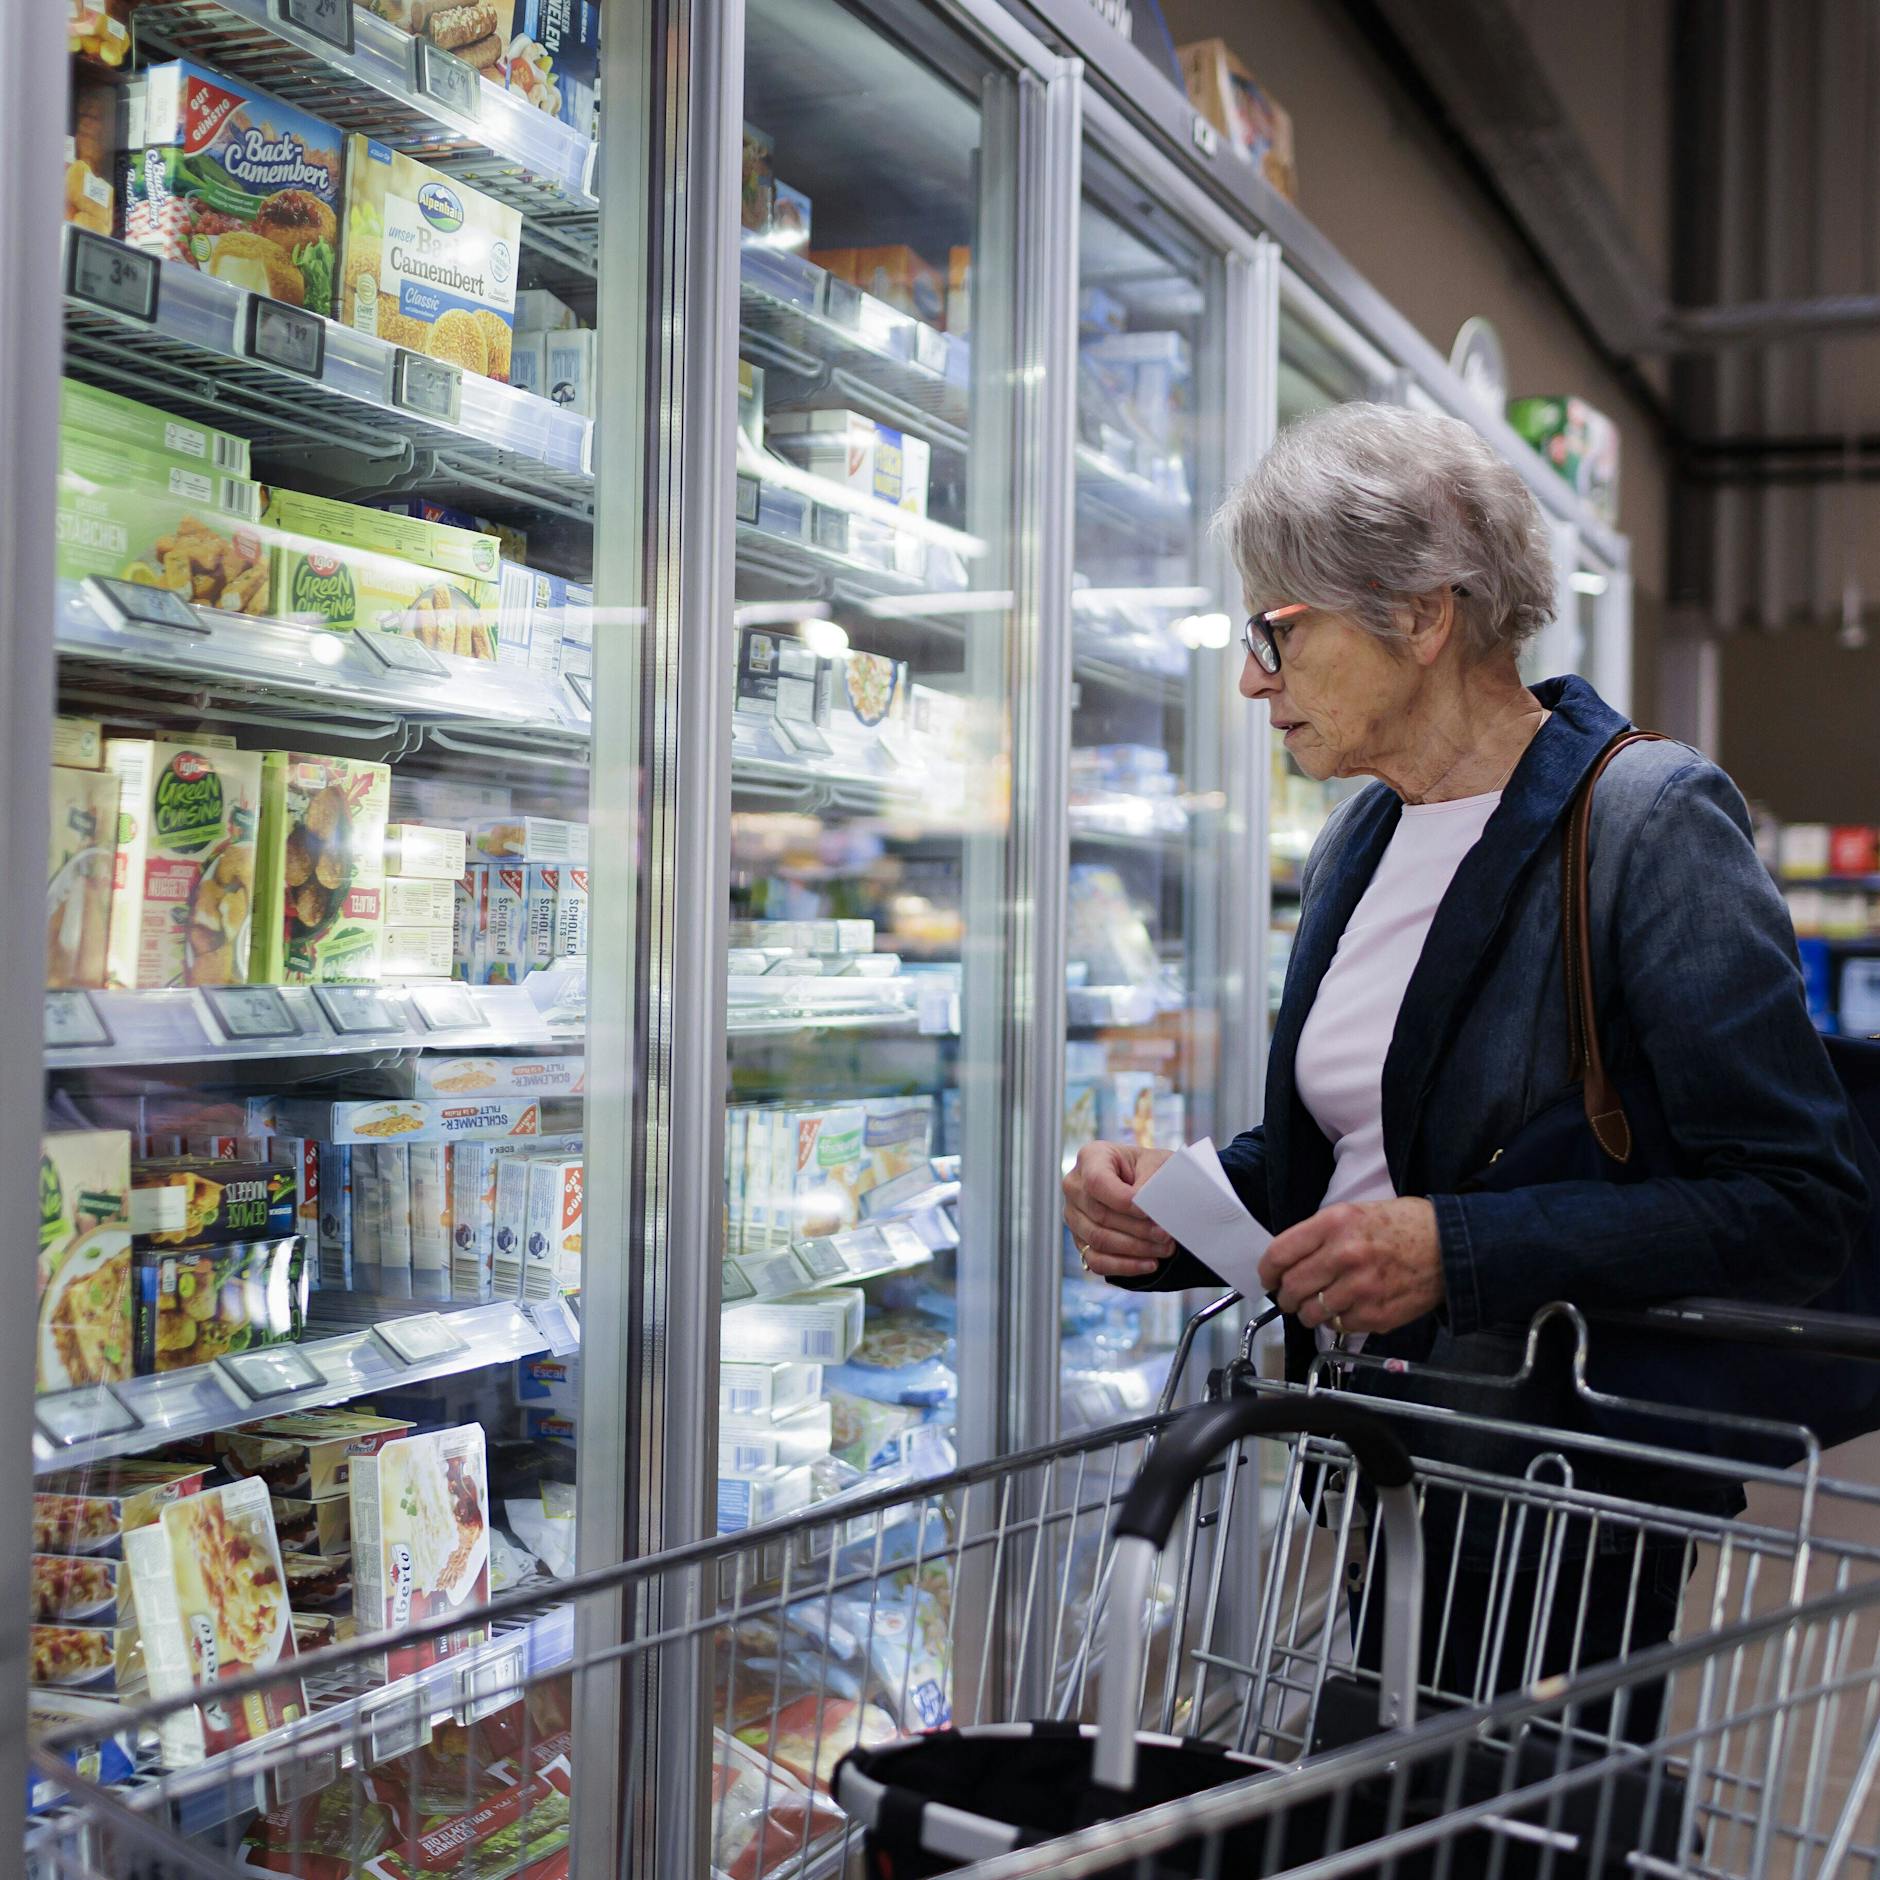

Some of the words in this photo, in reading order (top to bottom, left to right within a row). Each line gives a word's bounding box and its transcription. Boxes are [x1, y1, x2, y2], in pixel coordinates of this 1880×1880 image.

[190, 87, 210, 111] GUT
[201, 104, 212, 117] &
[245, 129, 303, 163] Back-
[225, 143, 329, 190] Camembert
[419, 191, 464, 224] Alpenhain
[388, 225, 415, 243] unser
[390, 245, 485, 297] Camembert
[404, 286, 440, 311] Classic
[489, 908, 498, 935] FILETS
[496, 897, 509, 956] SCHOLLEN
[530, 908, 539, 936] FILETS
[537, 897, 550, 956] SCHOLLEN
[559, 909, 568, 938] FILETS
[566, 898, 580, 956] SCHOLLEN
[440, 1113, 508, 1131] SCHLEMMER-
[480, 1105, 501, 1115] FILET
[489, 1144, 515, 1155] EDEKA
[225, 1180, 268, 1203] NUGGETS
[565, 1169, 581, 1193] GUT
[200, 1622, 222, 1721] Aerto
[422, 1835, 441, 1851] BIO
[438, 1821, 470, 1845] BLACK
[467, 1808, 495, 1827] TIGER
[429, 1827, 478, 1857] GARNELEN
